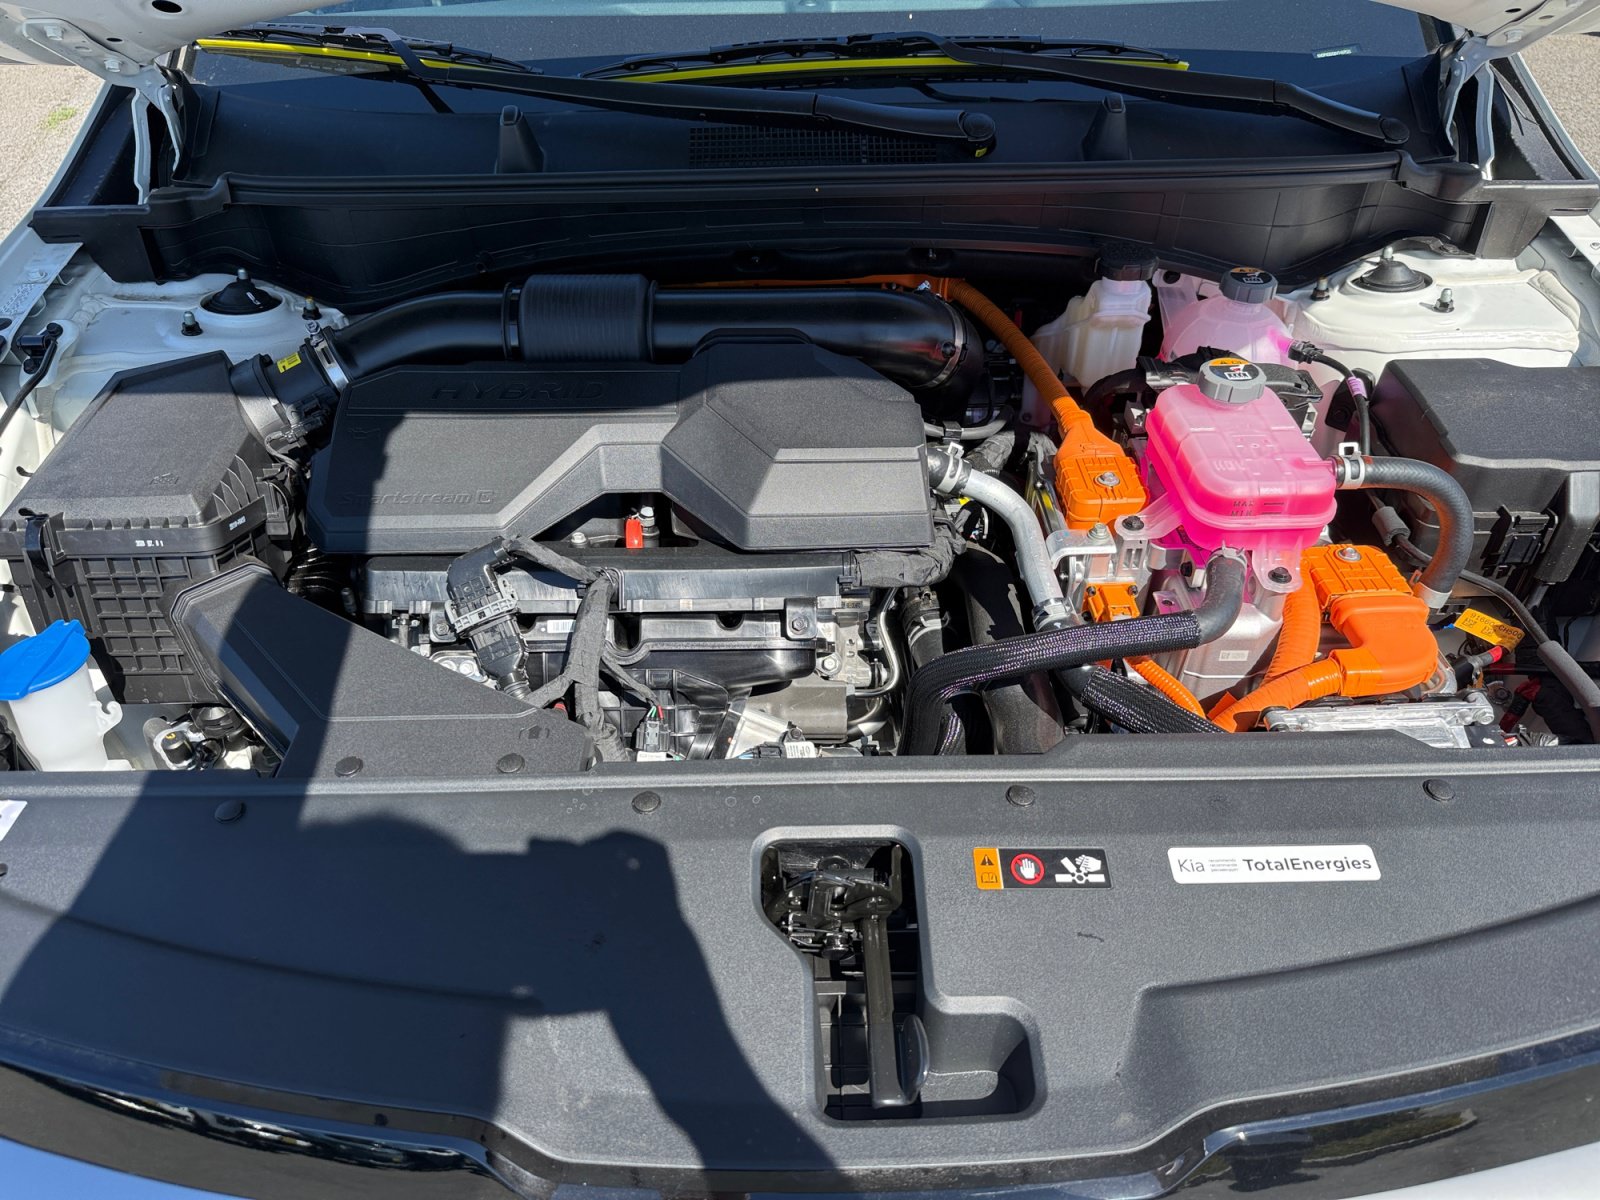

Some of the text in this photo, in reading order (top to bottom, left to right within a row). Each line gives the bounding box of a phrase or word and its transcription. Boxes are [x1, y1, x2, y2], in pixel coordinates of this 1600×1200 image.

[431, 382, 607, 400] HYBRID
[1177, 857, 1372, 873] Kia TotalEnergies
